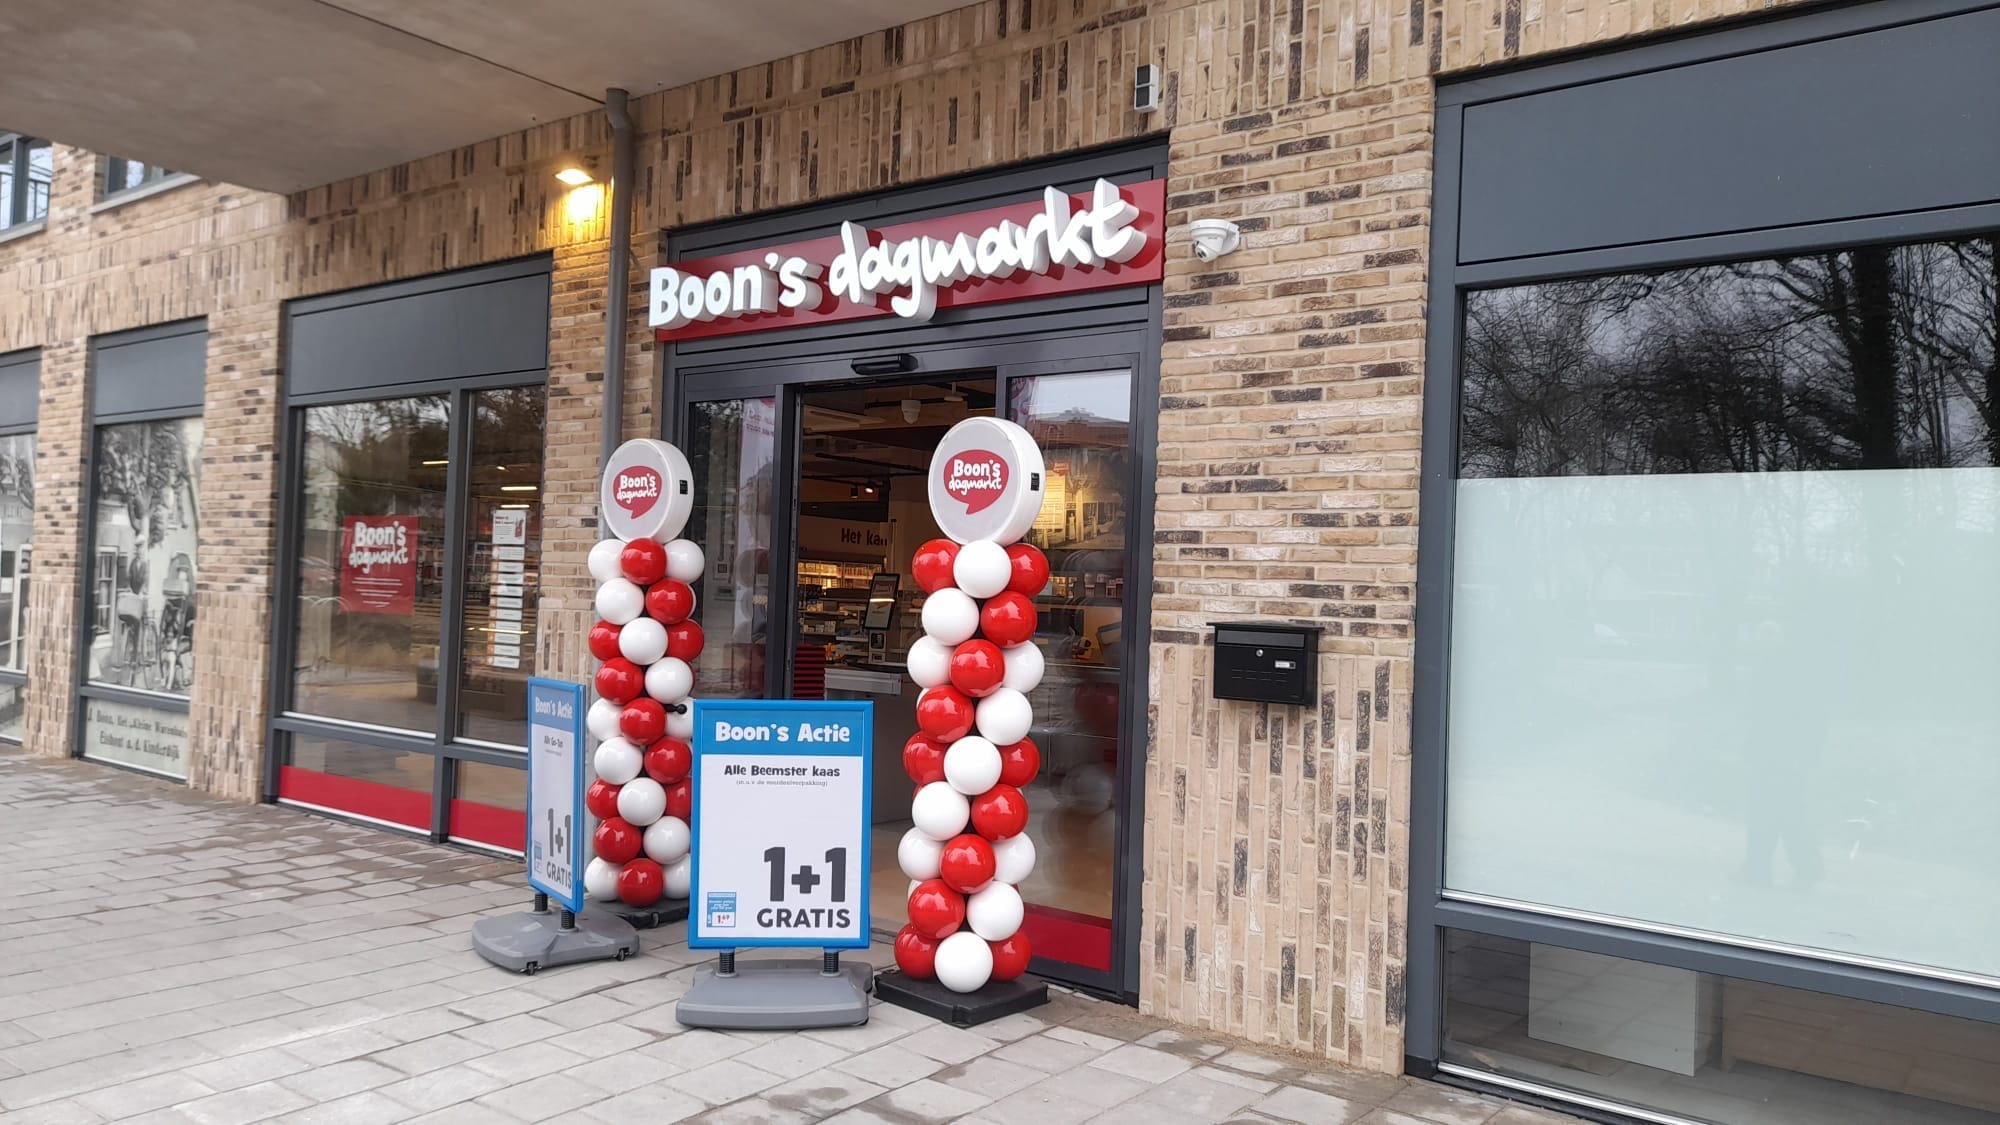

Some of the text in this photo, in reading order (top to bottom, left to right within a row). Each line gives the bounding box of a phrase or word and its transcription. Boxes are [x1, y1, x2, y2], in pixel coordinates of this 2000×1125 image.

[648, 177, 1148, 329] Boon's dagmarkt
[953, 459, 1001, 478] Boon's
[620, 473, 656, 490] Boon's
[948, 474, 1003, 496] dagmarkt
[616, 486, 658, 504] dagmarkt
[354, 520, 407, 548] Boon's
[841, 527, 862, 545] Het
[348, 543, 409, 574] dagmarkt
[535, 696, 573, 720] Boon's Actie
[715, 721, 851, 743] Boon's Actie
[724, 764, 841, 777] Alle Beemster kaas
[547, 807, 572, 865] 1+1
[546, 861, 572, 890] GRATIS
[763, 846, 847, 903] 1+1
[756, 908, 851, 929] GRATIS
